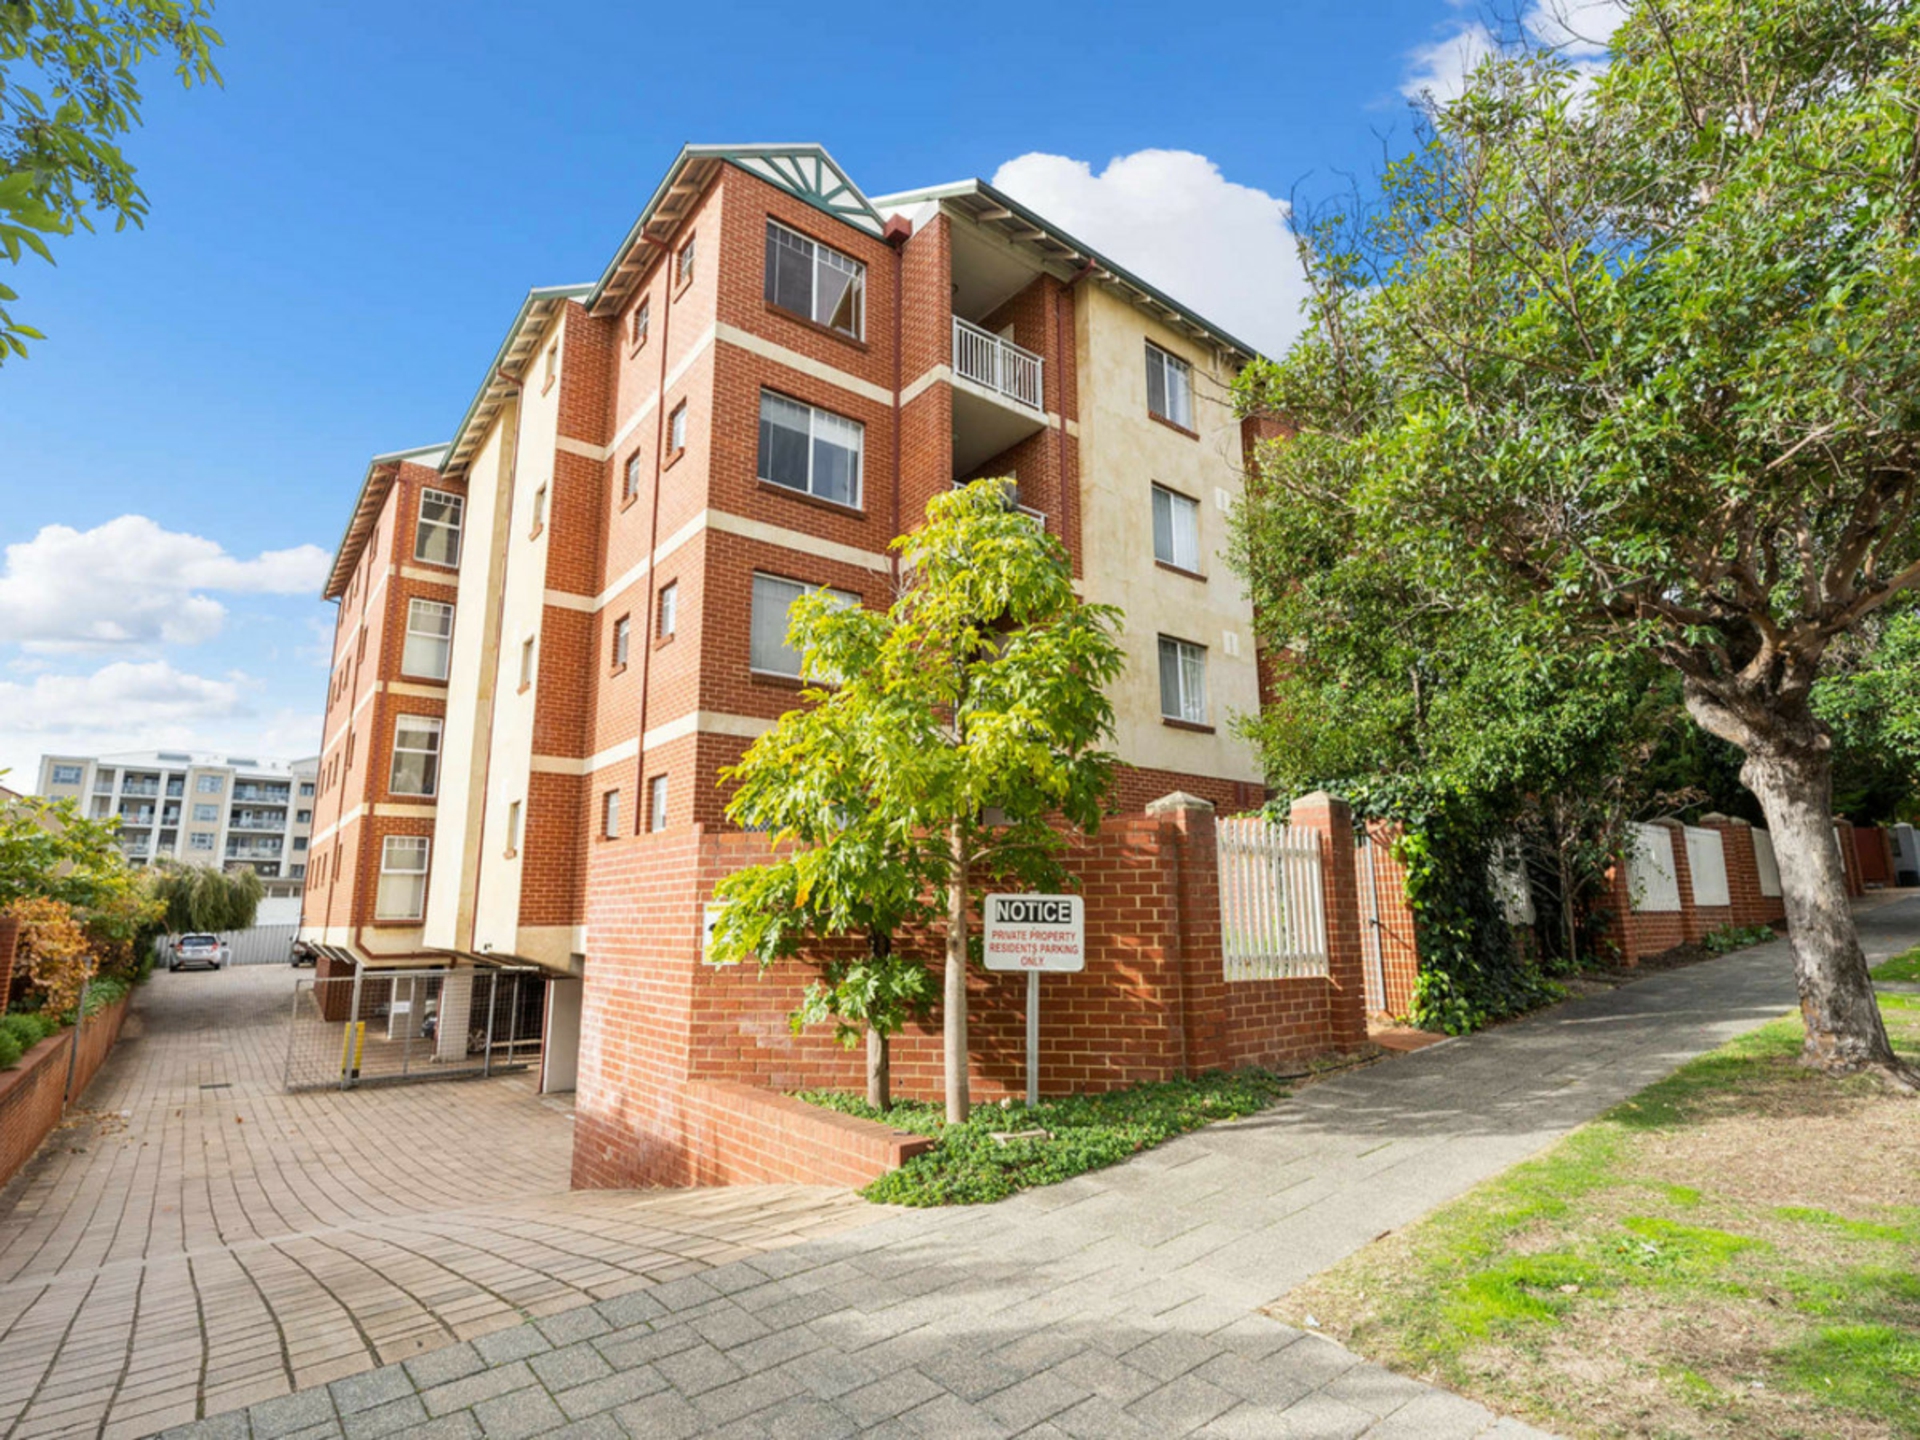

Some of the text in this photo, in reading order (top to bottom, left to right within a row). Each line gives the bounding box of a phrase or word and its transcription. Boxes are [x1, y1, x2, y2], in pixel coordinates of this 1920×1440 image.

[997, 901, 1070, 922] NOTICE
[992, 930, 1076, 941] PRIVATE PROPERTY
[989, 943, 1079, 954] RESIDENTS PARKING
[1021, 957, 1045, 966] ONLY
